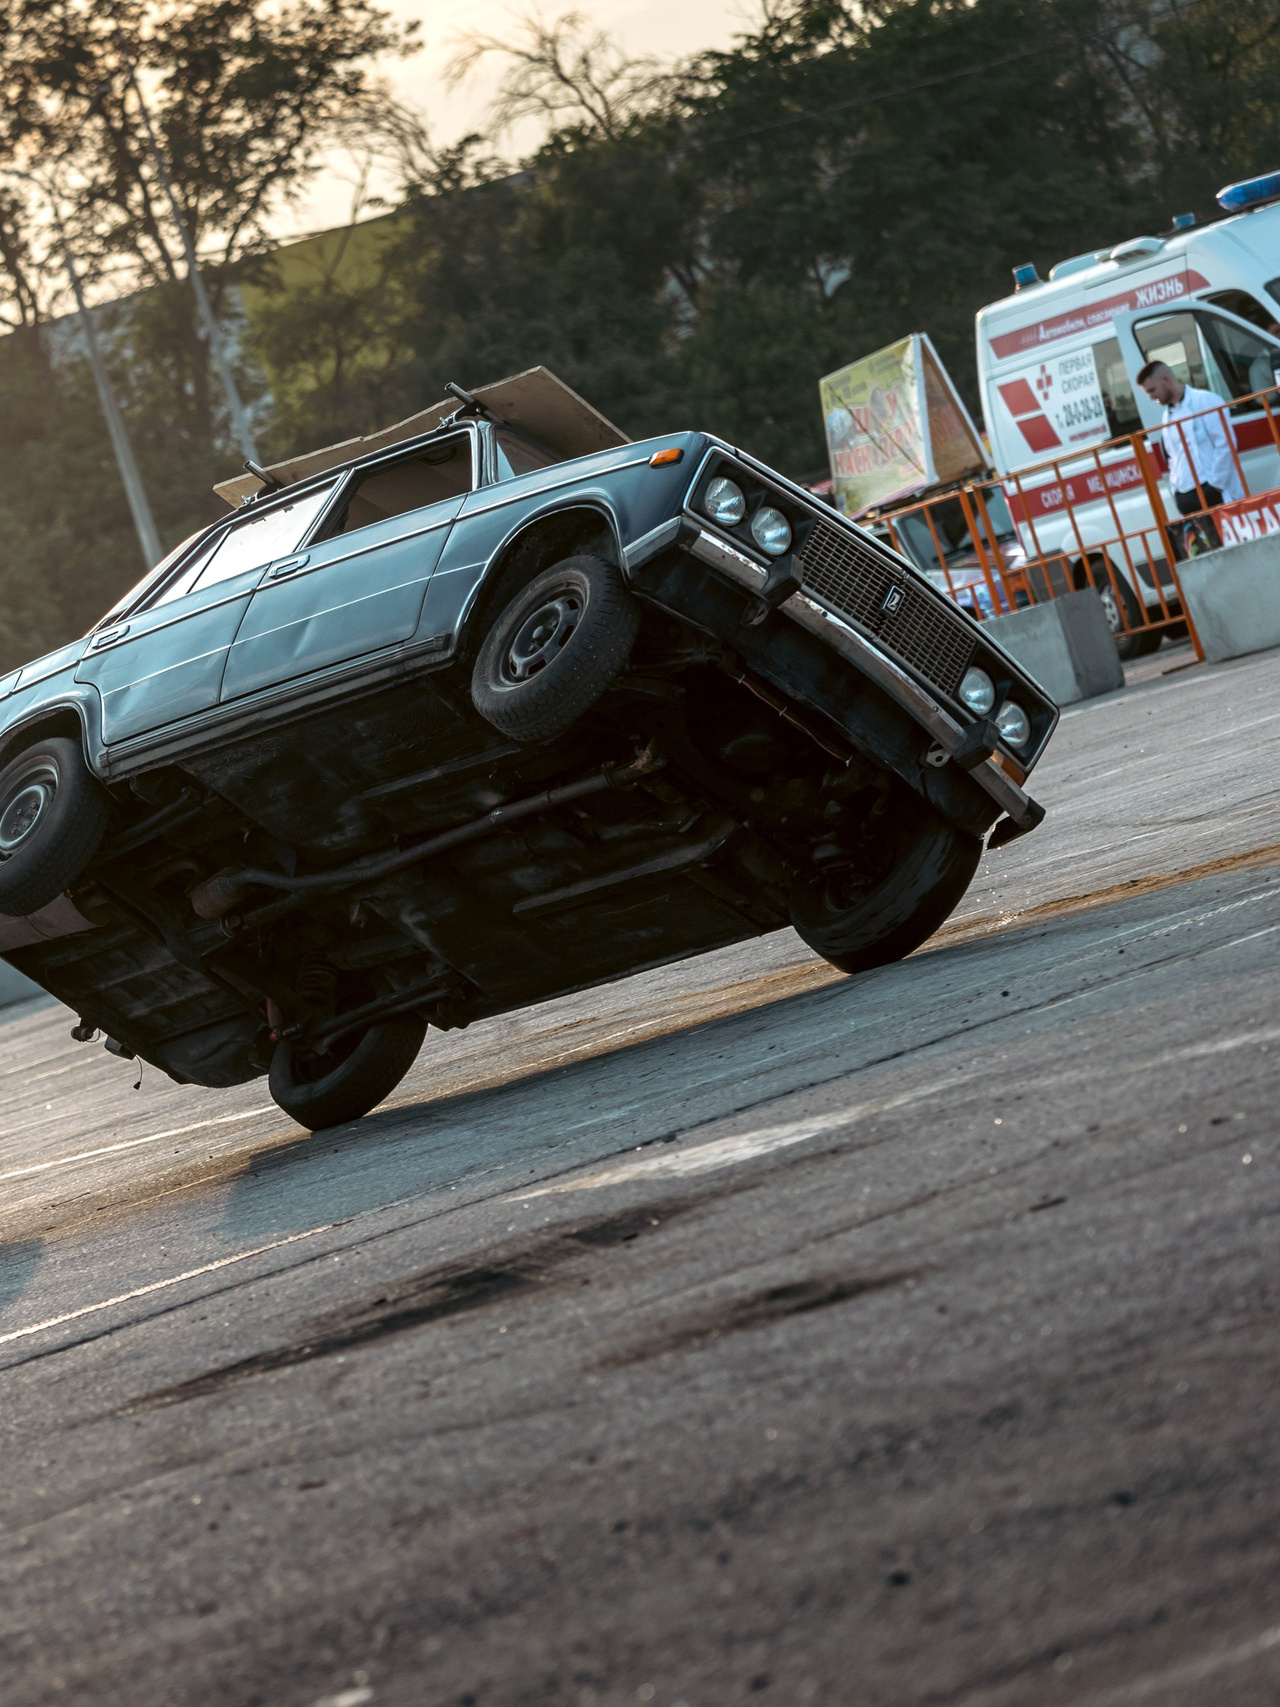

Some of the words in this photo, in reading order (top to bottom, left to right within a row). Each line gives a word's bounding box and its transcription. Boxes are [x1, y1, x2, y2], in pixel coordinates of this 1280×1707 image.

[1135, 277, 1184, 308] ЖИЗНЬ
[1059, 352, 1092, 376] ПЕРВАЯ
[1061, 371, 1095, 394] СКОРАЯ
[1221, 503, 1280, 547] АНГА
